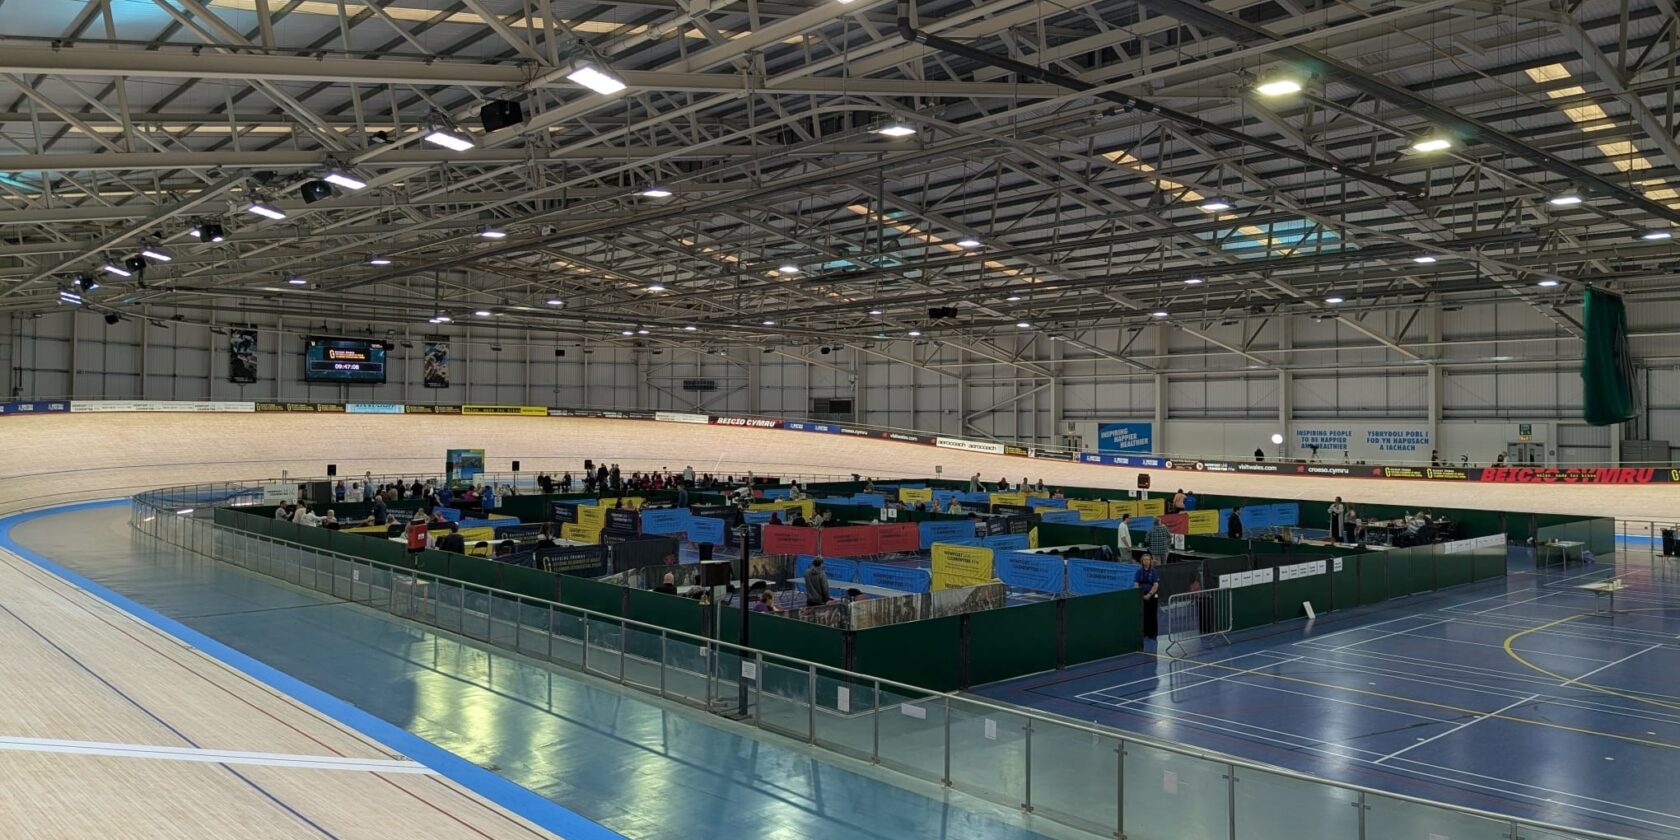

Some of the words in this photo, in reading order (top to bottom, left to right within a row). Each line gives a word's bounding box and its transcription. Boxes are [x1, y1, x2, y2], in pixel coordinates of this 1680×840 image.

[717, 417, 745, 425] BEICIO
[746, 419, 776, 427] CYMRU
[1101, 428, 1128, 438] INSPIRING
[1114, 433, 1137, 442] HAPPIER
[1120, 438, 1148, 448] HEALTHIER
